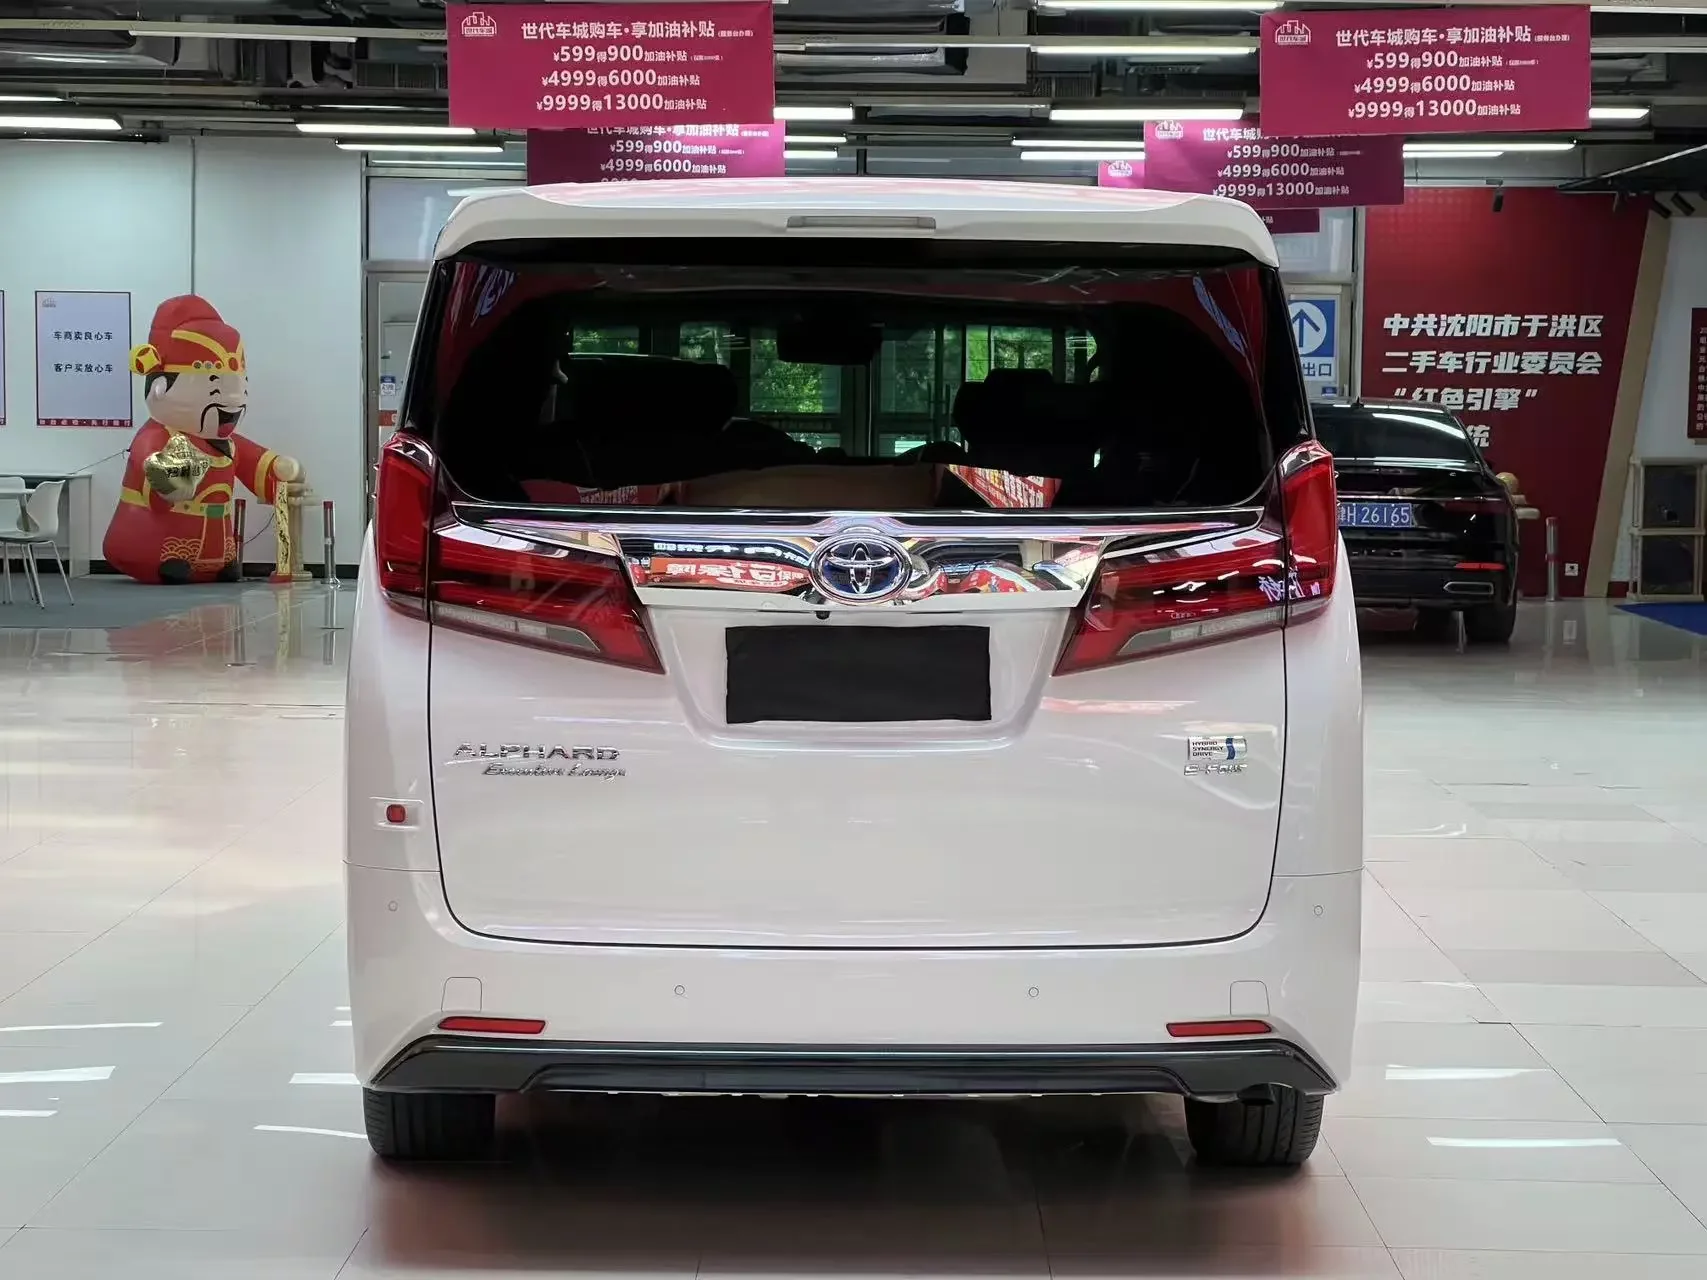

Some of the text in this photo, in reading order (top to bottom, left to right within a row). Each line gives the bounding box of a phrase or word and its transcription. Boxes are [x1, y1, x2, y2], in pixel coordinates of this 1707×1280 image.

[521, 20, 716, 40] 世代车城购车·享加油补贴
[1336, 25, 1532, 47] 世代车城购车·享加油补贴
[553, 45, 688, 62] ¥599得900加油补贴
[1366, 51, 1503, 69] ¥599得900加油补贴
[541, 69, 700, 87] ¥4999得6000加油补贴
[1354, 74, 1515, 94] ¥4999得6000加油补贴
[536, 94, 707, 112] ¥9999得13000加油补贴
[1348, 99, 1521, 119] ¥9999得13000加油补贴
[1383, 313, 1604, 338] 中共沈阳市于洪区
[53, 363, 113, 373] 客户买放心车
[1302, 362, 1332, 377] 出口
[1382, 351, 1604, 375] 二手车行业委员会
[454, 742, 620, 760] ALPHARD
